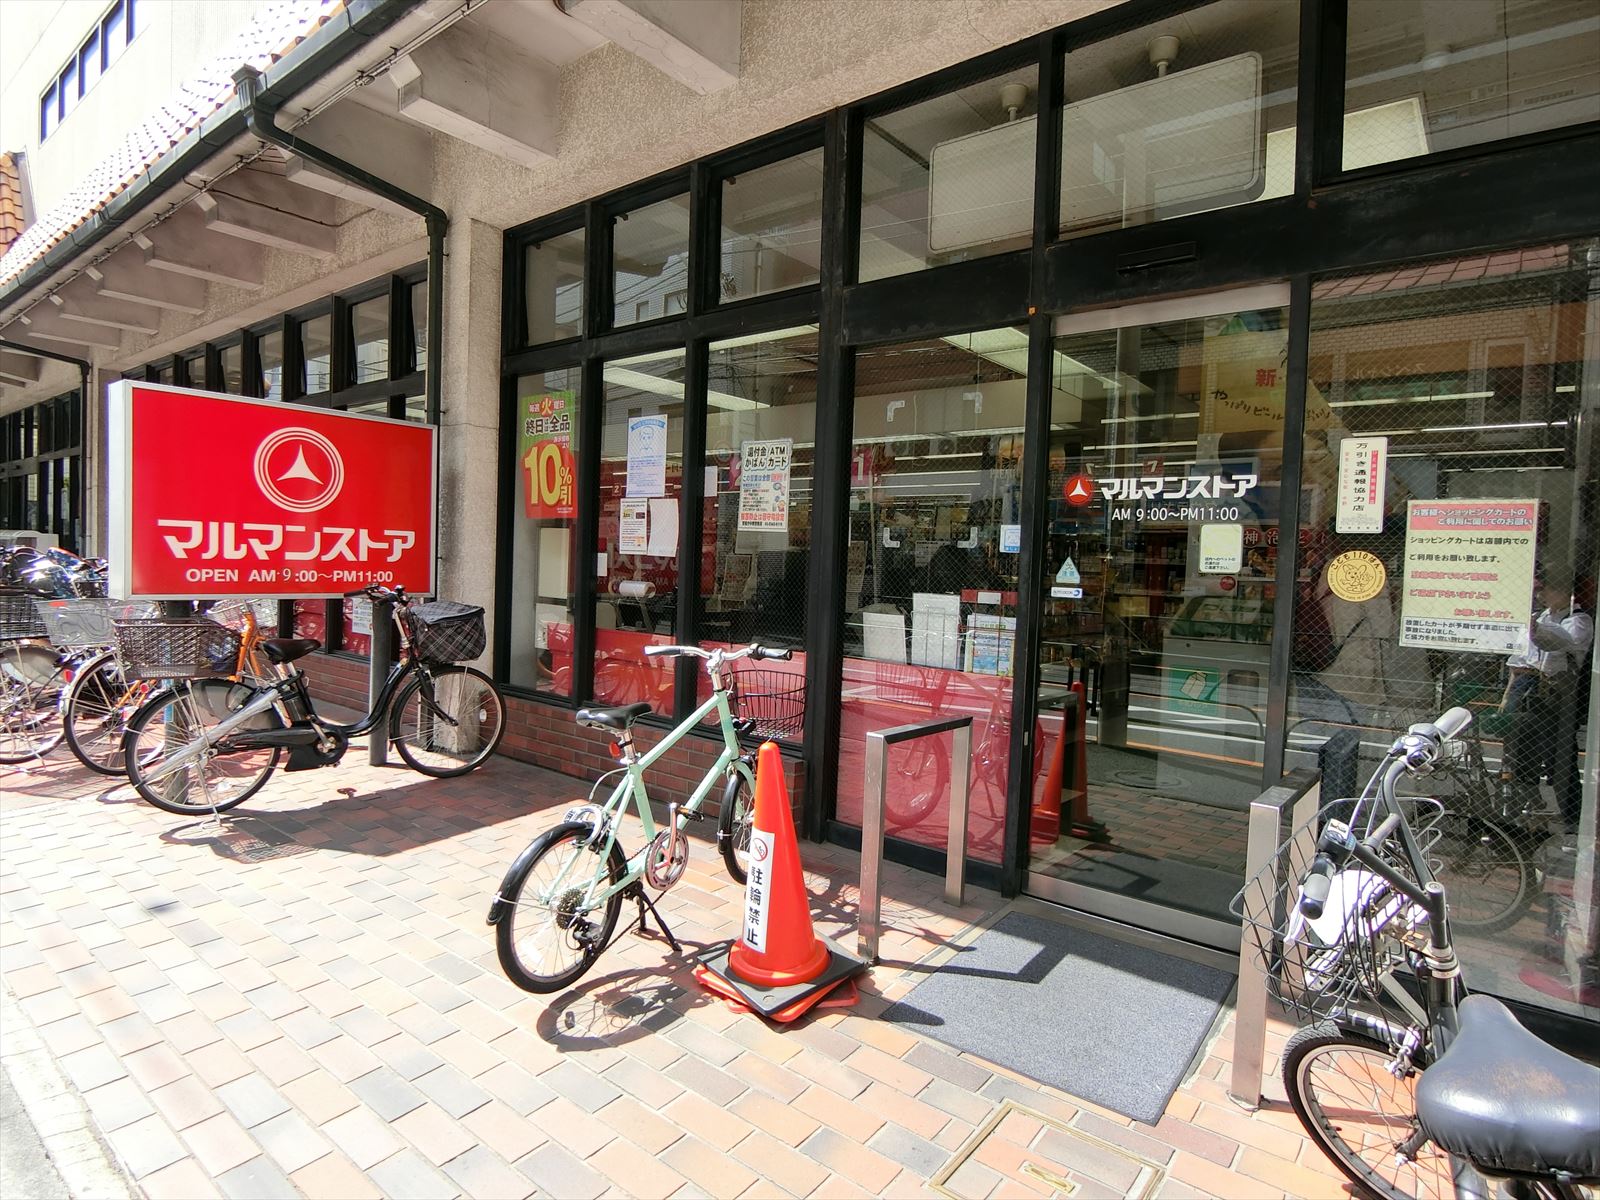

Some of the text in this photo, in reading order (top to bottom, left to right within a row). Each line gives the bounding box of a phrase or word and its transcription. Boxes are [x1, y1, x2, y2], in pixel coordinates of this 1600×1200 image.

[769, 446, 786, 456] ATM
[767, 456, 787, 468] カード
[1098, 474, 1258, 500] マルマンストア
[1112, 508, 1131, 521] AM
[157, 518, 416, 562] マルマンストア
[185, 568, 239, 582] OPEN
[248, 570, 276, 583] AM
[746, 865, 764, 946] 駐輪禁止
